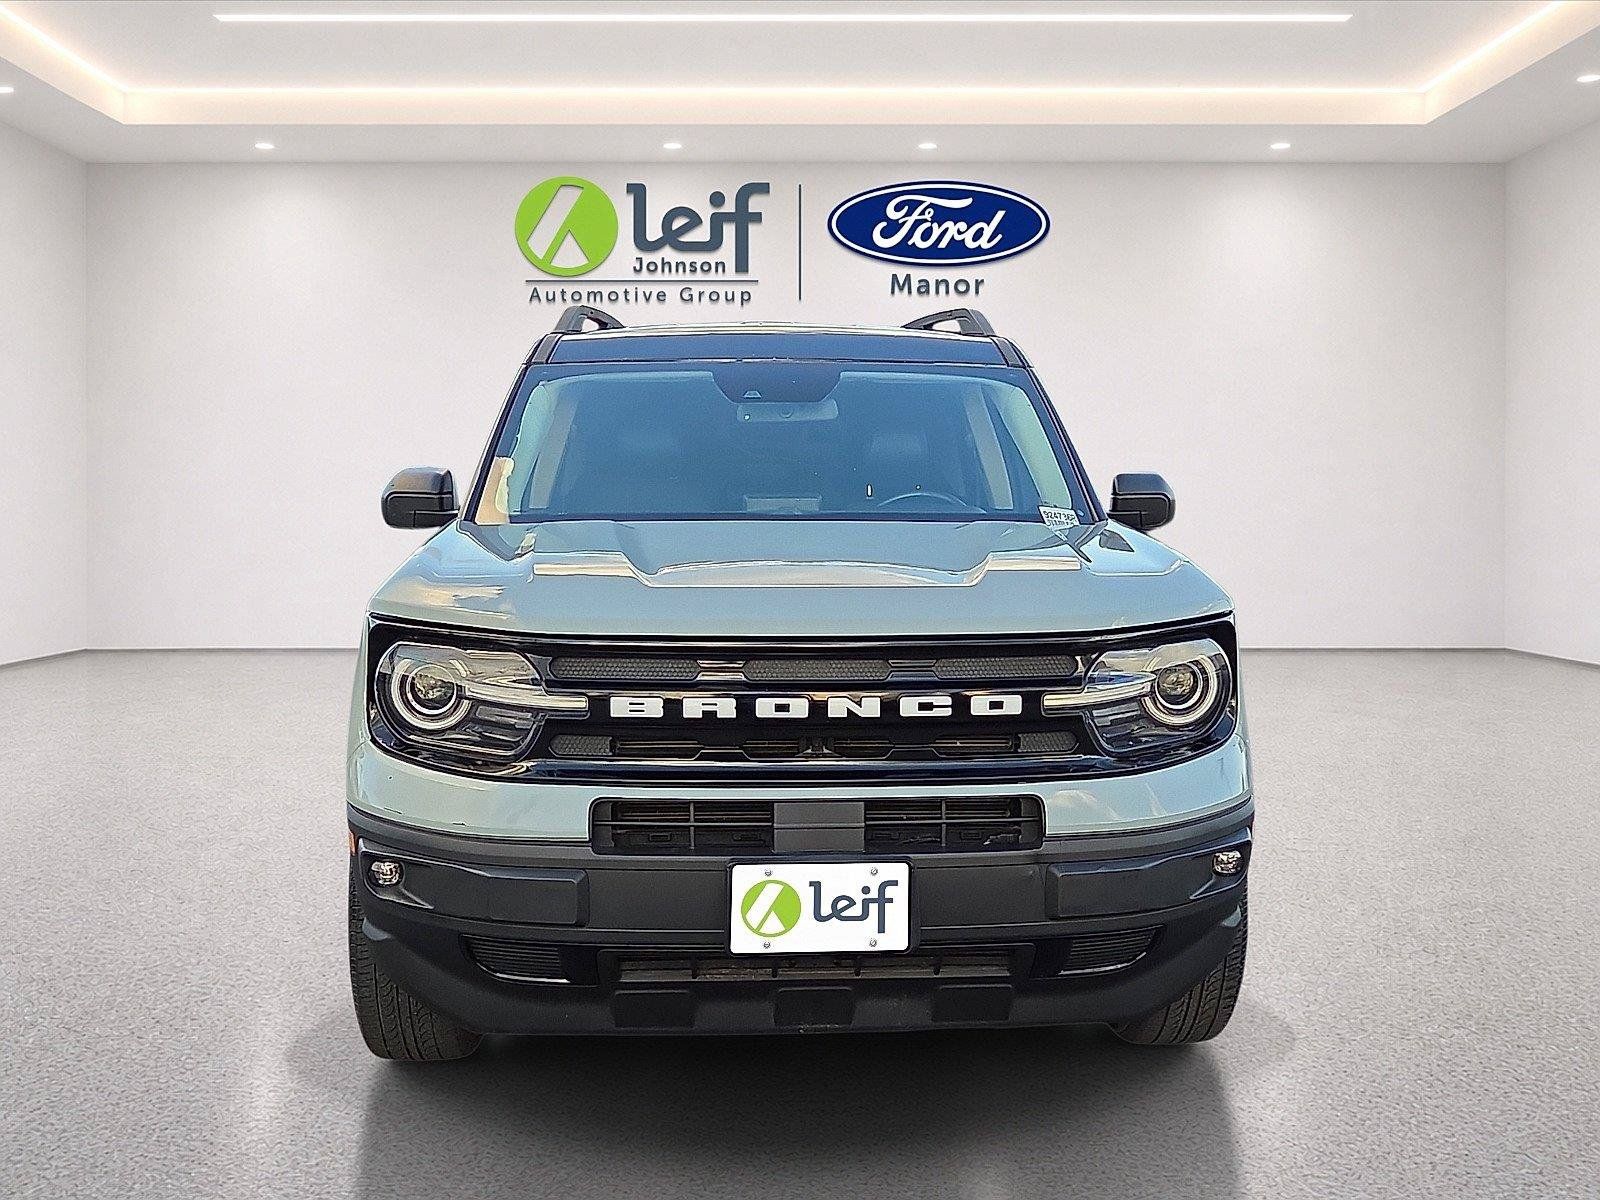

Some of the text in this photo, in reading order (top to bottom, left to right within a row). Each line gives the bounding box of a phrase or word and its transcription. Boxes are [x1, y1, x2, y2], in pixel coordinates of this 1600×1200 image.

[626, 182, 769, 273] leif
[872, 194, 1005, 249] Ford
[633, 257, 726, 274] Johnson
[528, 286, 752, 306] Automotive Group
[890, 273, 985, 295] Manor
[609, 694, 1023, 718] BRONCO
[808, 879, 899, 934] leif
